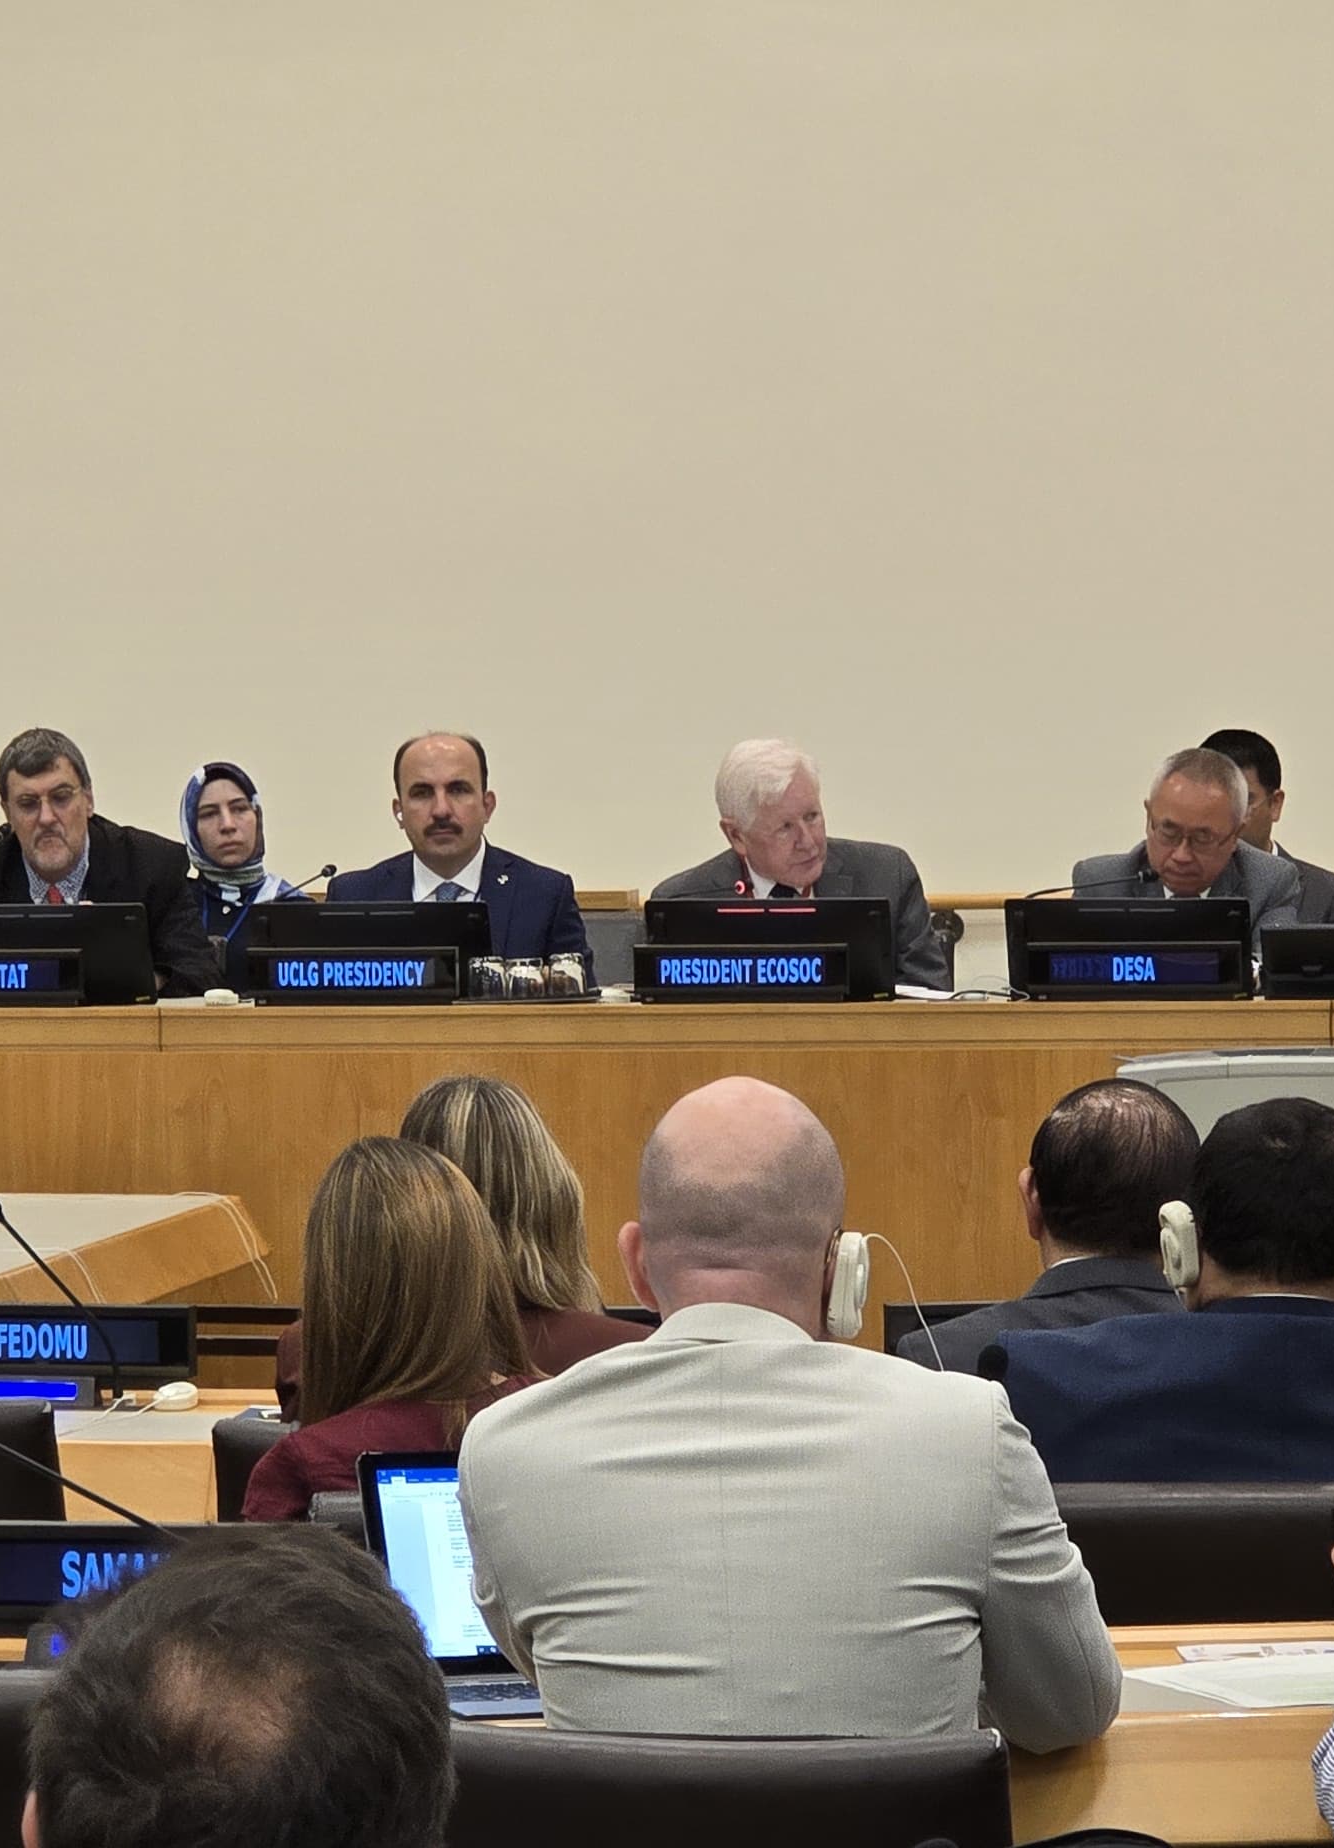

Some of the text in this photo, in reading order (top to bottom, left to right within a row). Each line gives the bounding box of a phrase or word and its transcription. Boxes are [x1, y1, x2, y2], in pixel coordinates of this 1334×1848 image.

[277, 960, 425, 987] UCLG PRESIDENCY
[660, 957, 822, 984] PRESIDENT ECOSOC
[1112, 956, 1156, 982] DESA
